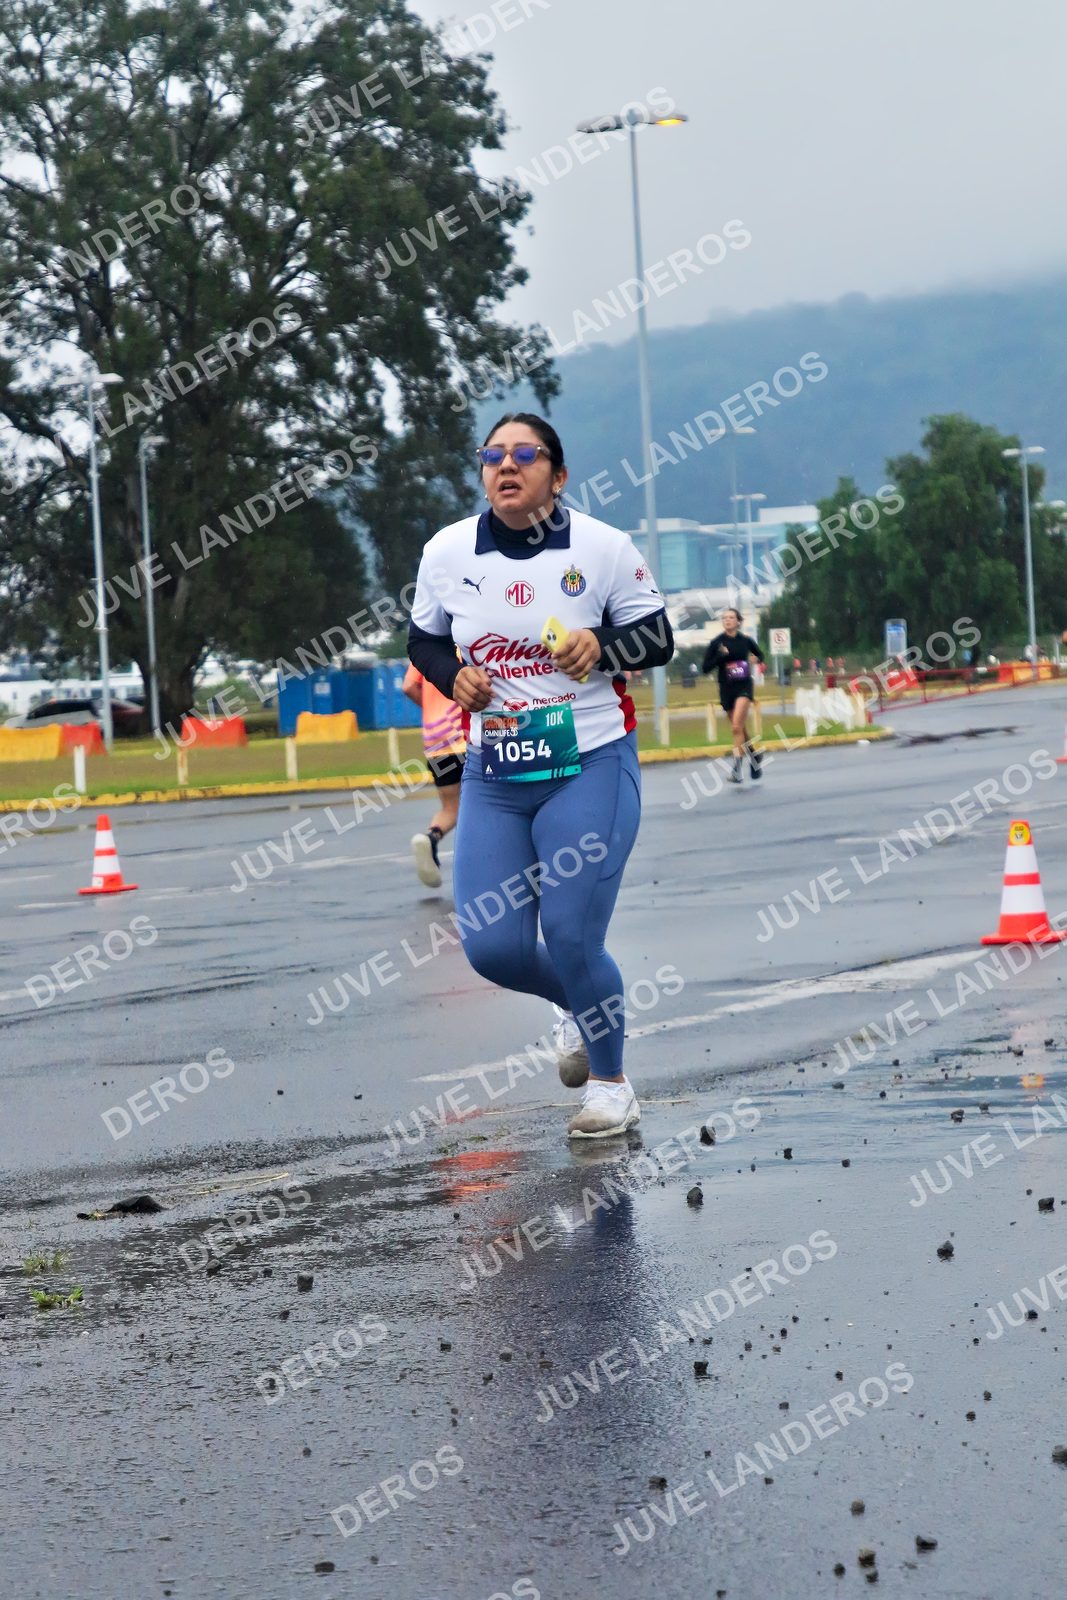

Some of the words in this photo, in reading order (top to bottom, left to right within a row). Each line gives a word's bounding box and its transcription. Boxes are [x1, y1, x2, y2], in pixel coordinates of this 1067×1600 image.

[507, 582, 533, 605] MG
[465, 632, 552, 666] Calien
[533, 692, 576, 705] mercado
[545, 711, 564, 727] 10K
[494, 739, 552, 762] 1054
